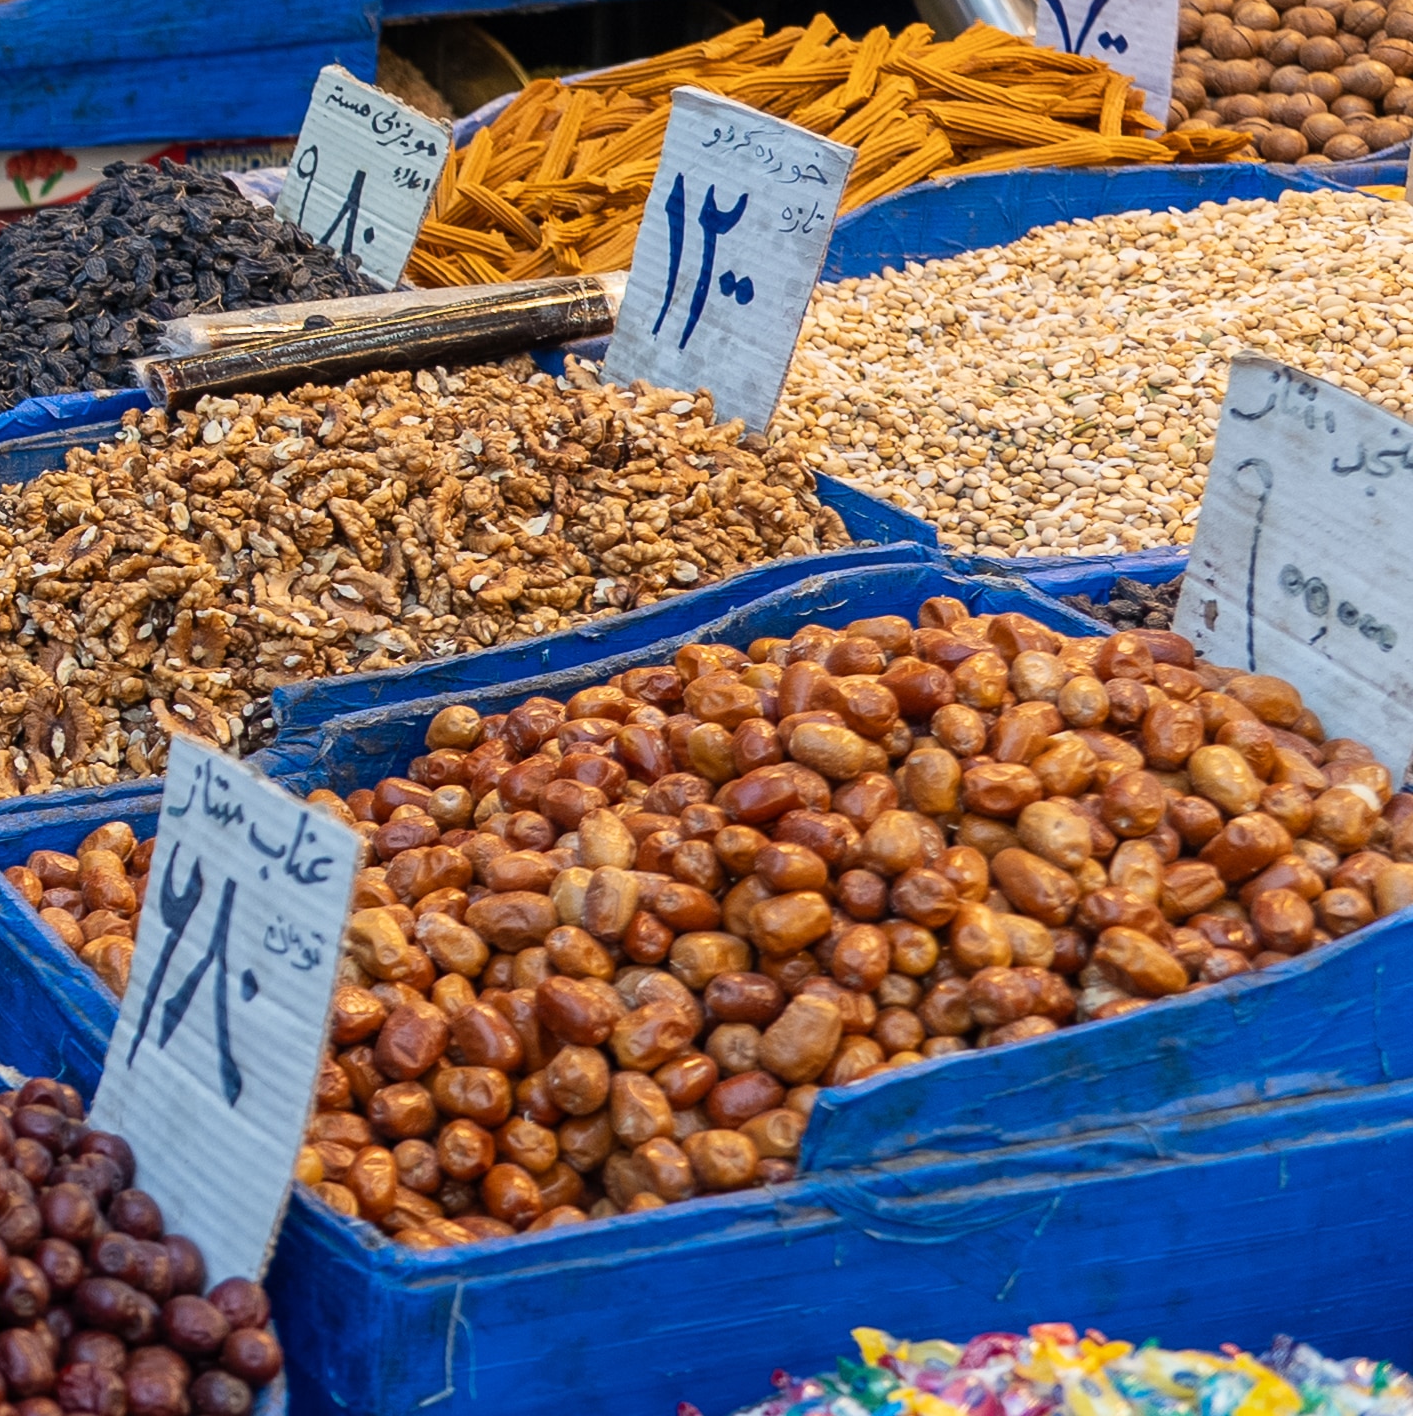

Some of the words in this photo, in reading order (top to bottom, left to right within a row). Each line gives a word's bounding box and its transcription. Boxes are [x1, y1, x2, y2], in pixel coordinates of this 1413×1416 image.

[297, 145, 376, 256] ۹۸۰
[778, 201, 825, 234] تازه
[652, 172, 755, 351] ۱۲۰۰
[166, 758, 245, 828] ممتاز
[248, 810, 335, 886] عناب
